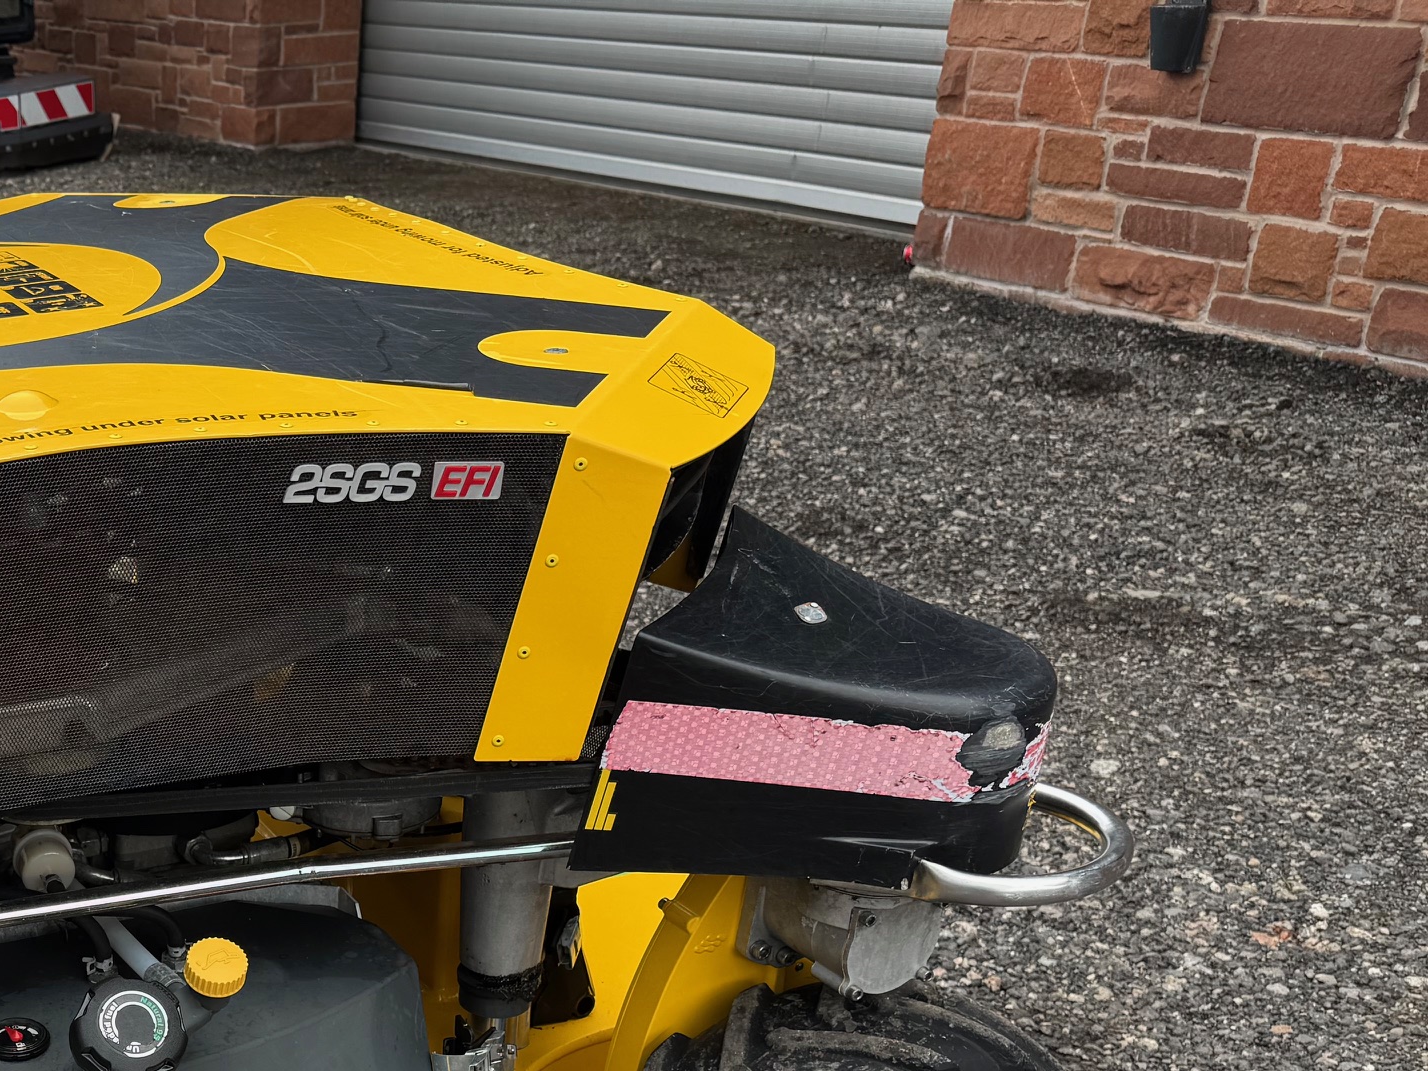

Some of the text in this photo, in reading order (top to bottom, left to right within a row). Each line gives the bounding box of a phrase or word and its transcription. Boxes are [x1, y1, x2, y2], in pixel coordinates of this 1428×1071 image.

[80, 417, 165, 432] under
[175, 411, 248, 424] solar
[258, 409, 358, 421] panels
[282, 462, 502, 504] 2SGS EFI
[140, 996, 164, 1028] Natural
